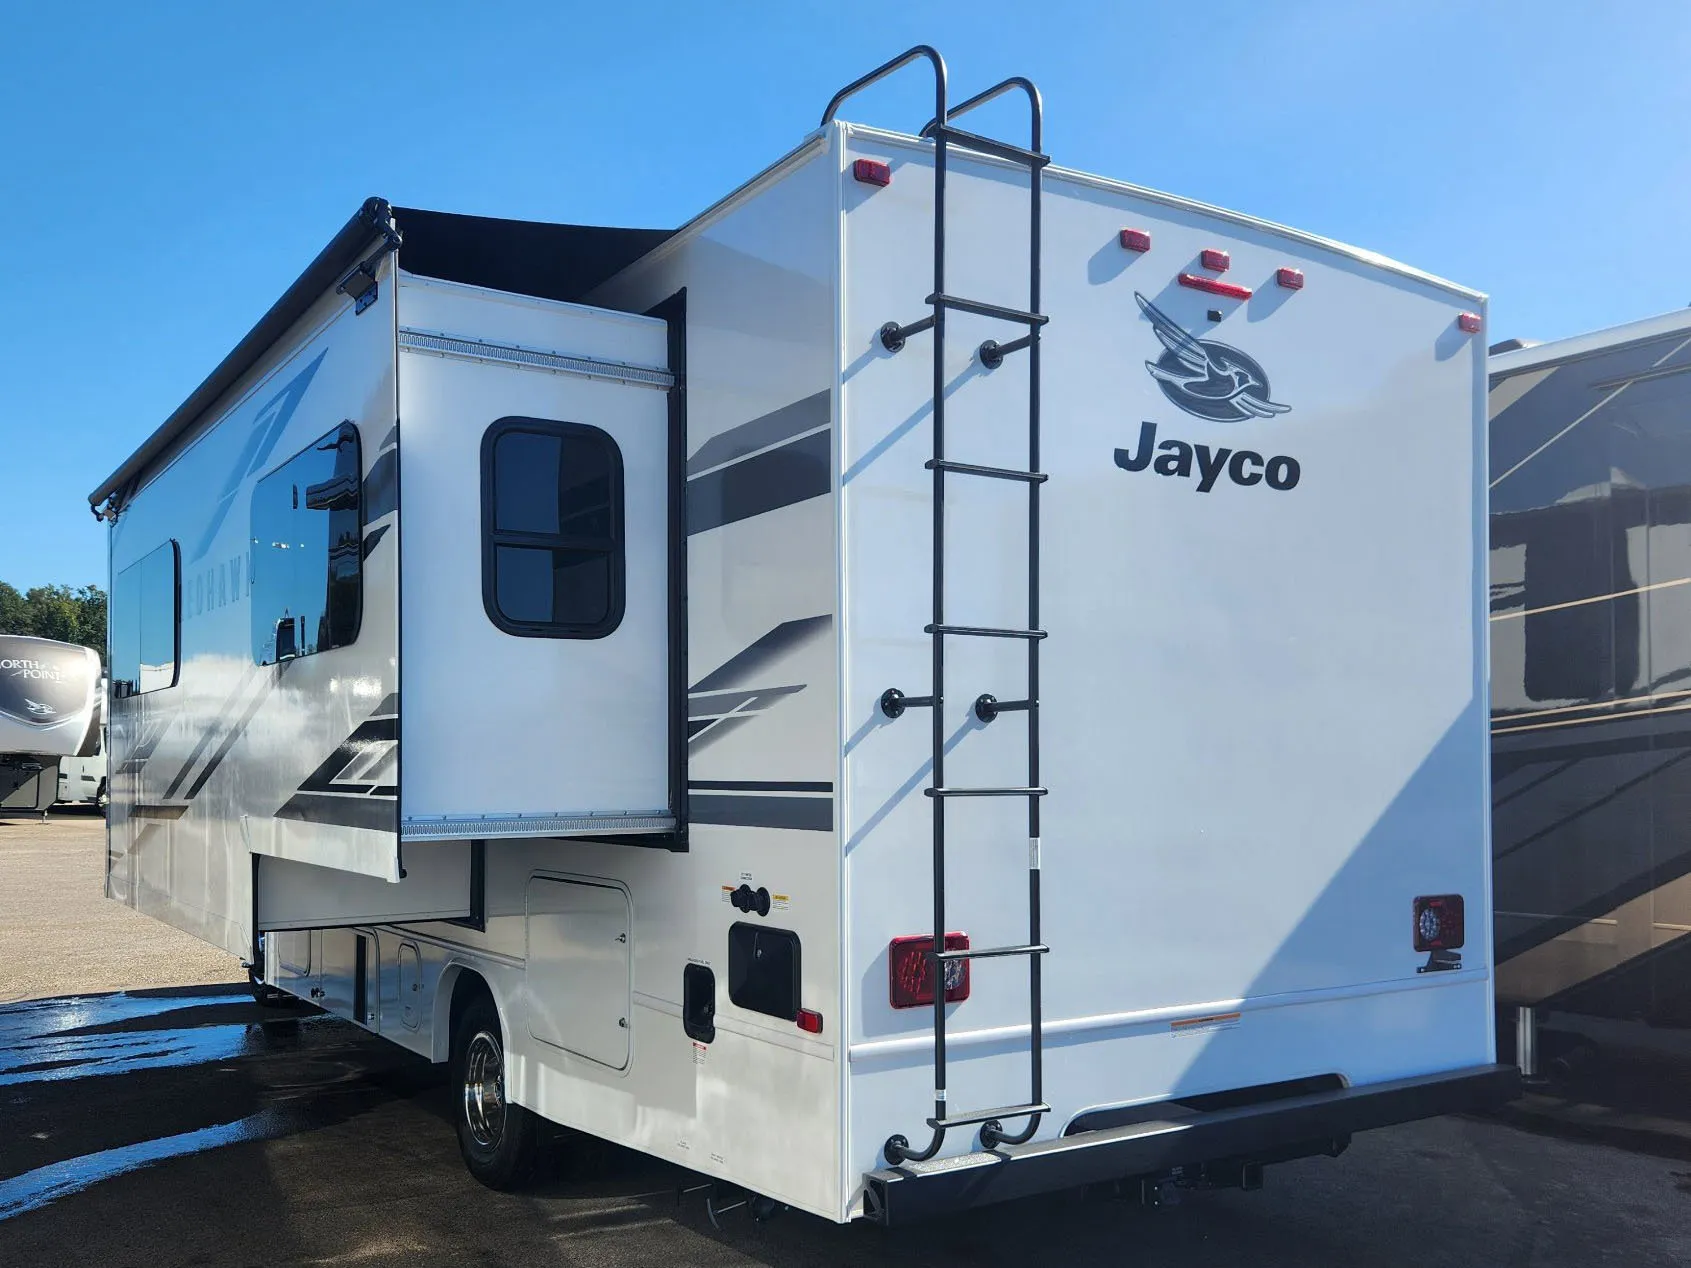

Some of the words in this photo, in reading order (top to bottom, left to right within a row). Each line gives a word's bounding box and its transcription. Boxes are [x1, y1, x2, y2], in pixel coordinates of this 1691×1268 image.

[1114, 421, 1301, 493] Jayco
[0, 659, 39, 669] ORTH
[23, 668, 62, 680] POINT
